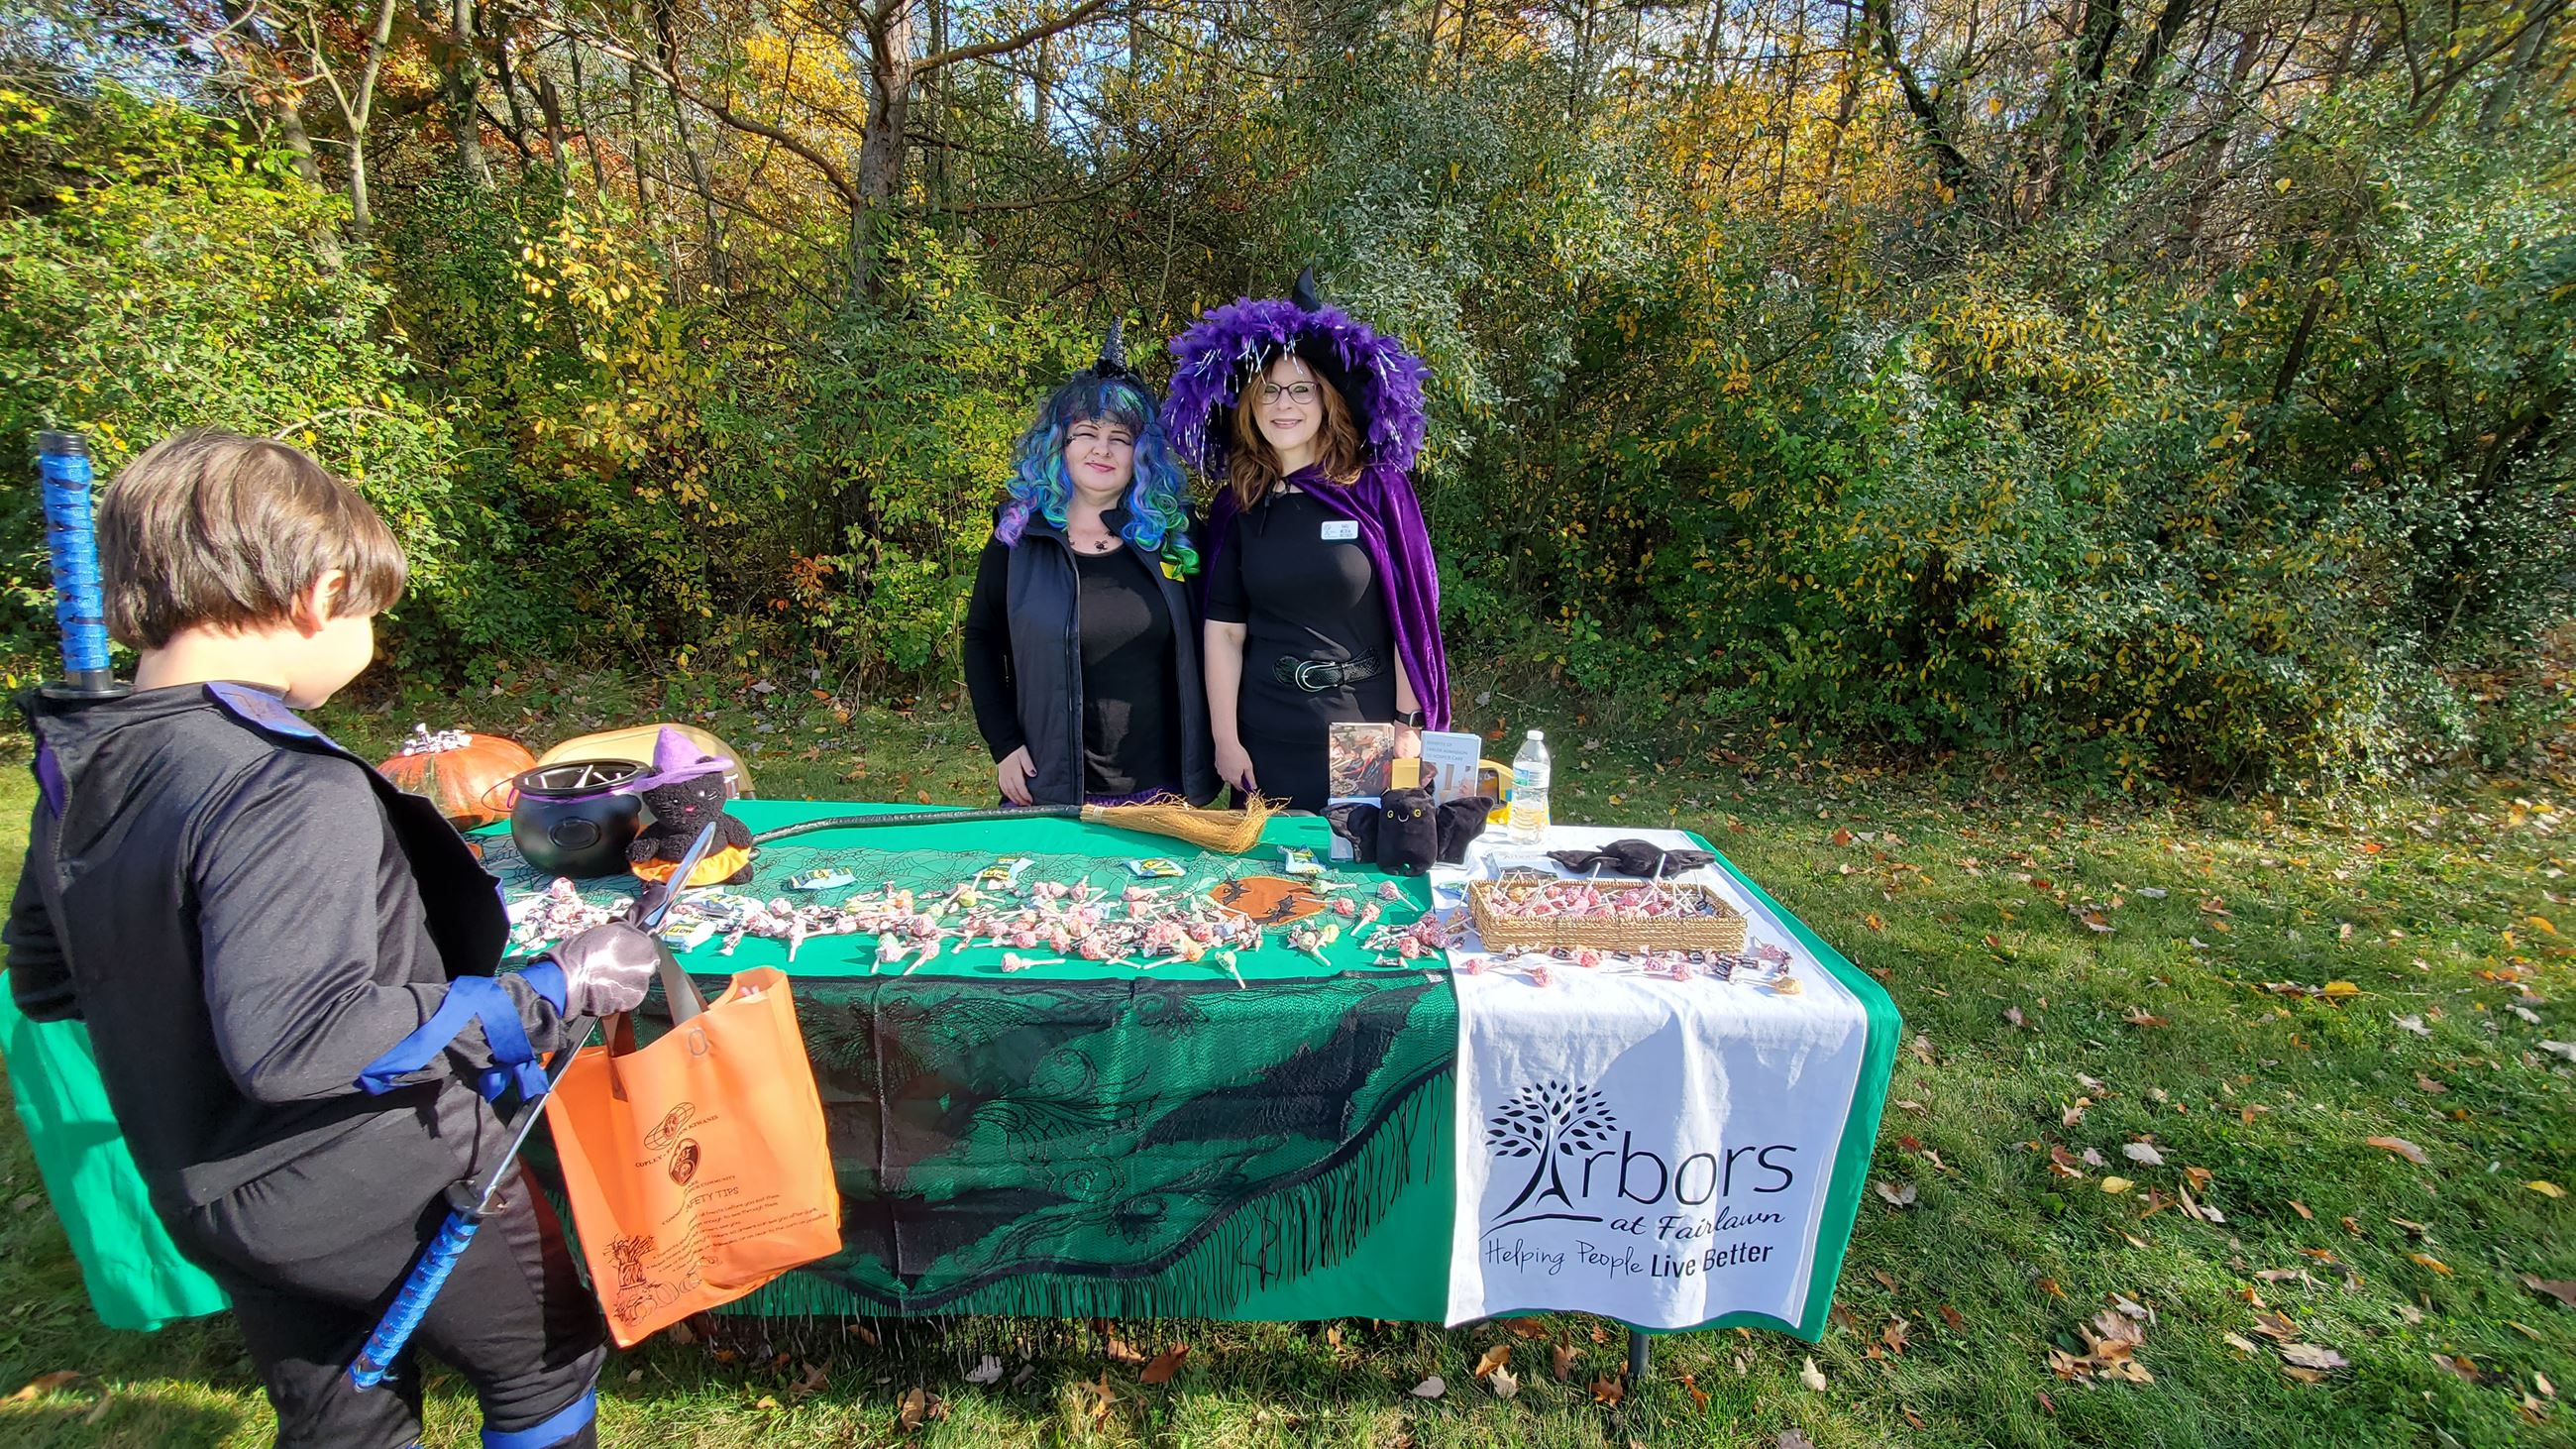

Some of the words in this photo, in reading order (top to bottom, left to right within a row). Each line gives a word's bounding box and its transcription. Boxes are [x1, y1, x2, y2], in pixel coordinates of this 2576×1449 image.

[686, 1192, 713, 1212] AFETY
[715, 1186, 739, 1198] TIPS
[1610, 1217, 1646, 1235] at
[1657, 1205, 1785, 1243] Fairlawn
[1486, 1238, 1565, 1274] Helping
[1576, 1240, 1644, 1279] People
[1651, 1253, 1696, 1279] Live
[1702, 1243, 1773, 1272] Better
